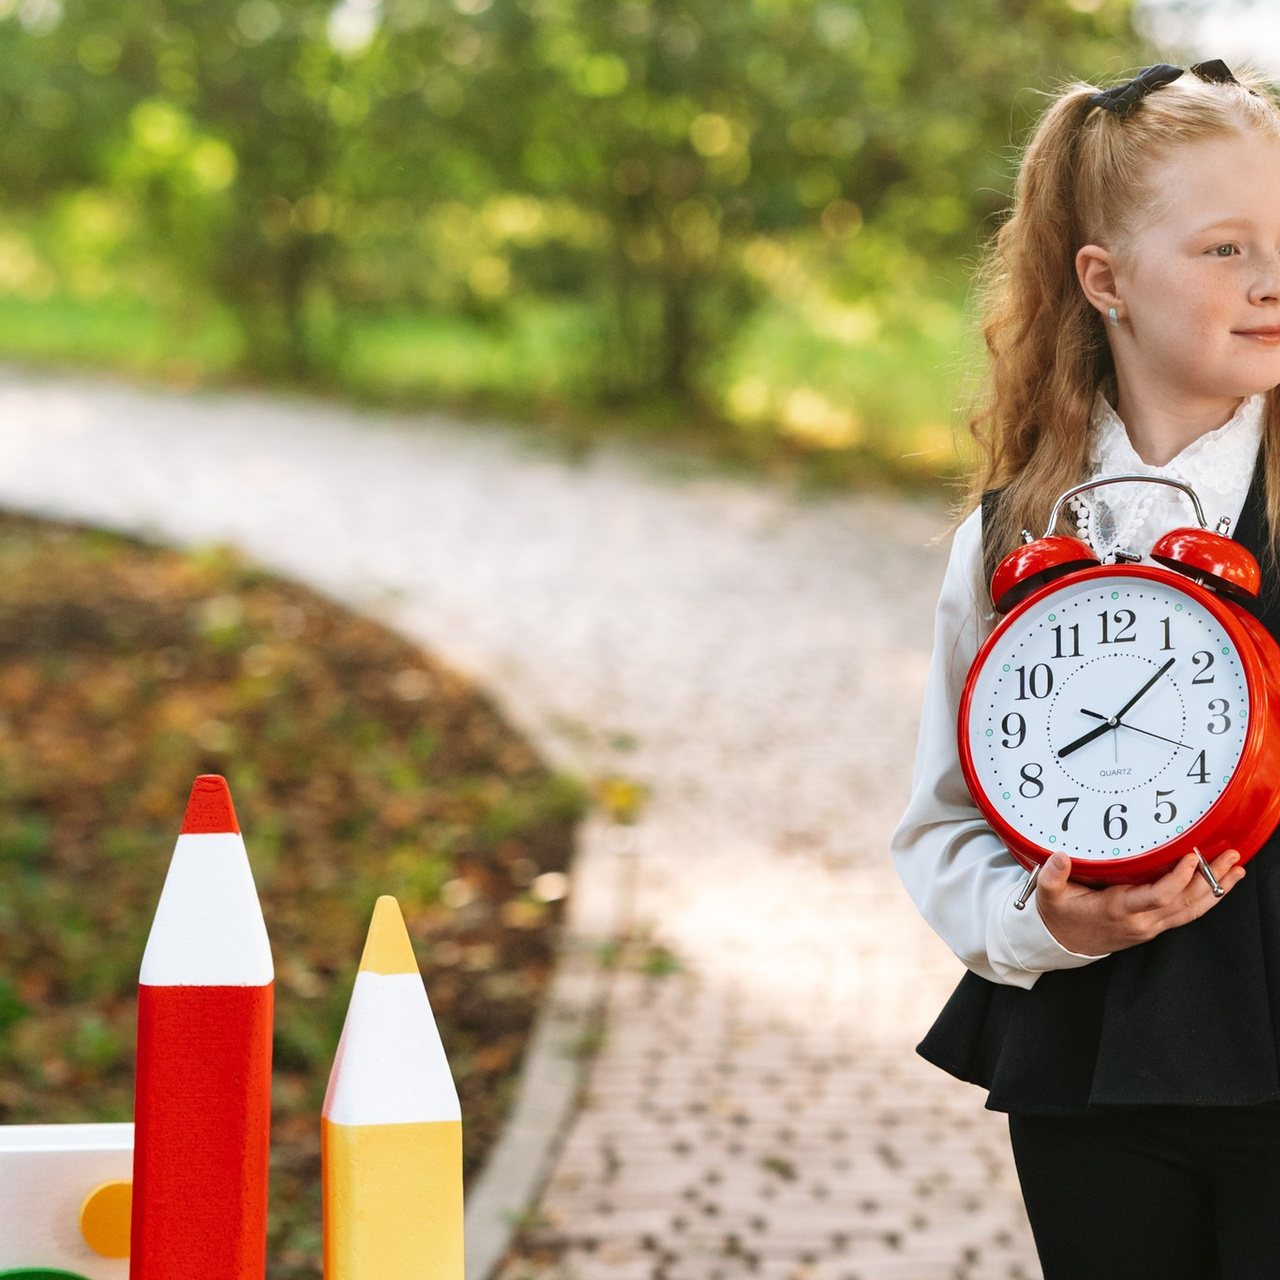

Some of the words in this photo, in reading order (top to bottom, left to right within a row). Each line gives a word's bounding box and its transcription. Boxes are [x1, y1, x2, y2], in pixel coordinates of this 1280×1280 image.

[1051, 623, 1085, 658] 11
[1097, 609, 1137, 644] 12
[1159, 616, 1175, 650] 1
[1014, 663, 1053, 700] 10
[1191, 650, 1215, 684] 2
[1001, 712, 1026, 749] 9
[1206, 698, 1231, 734] 3
[1019, 762, 1043, 798] 8
[1099, 768, 1132, 777] QUARTZ
[1187, 749, 1210, 784] 4
[1056, 797, 1079, 831] 7
[1103, 804, 1128, 839] 6
[1154, 789, 1177, 823] 5
